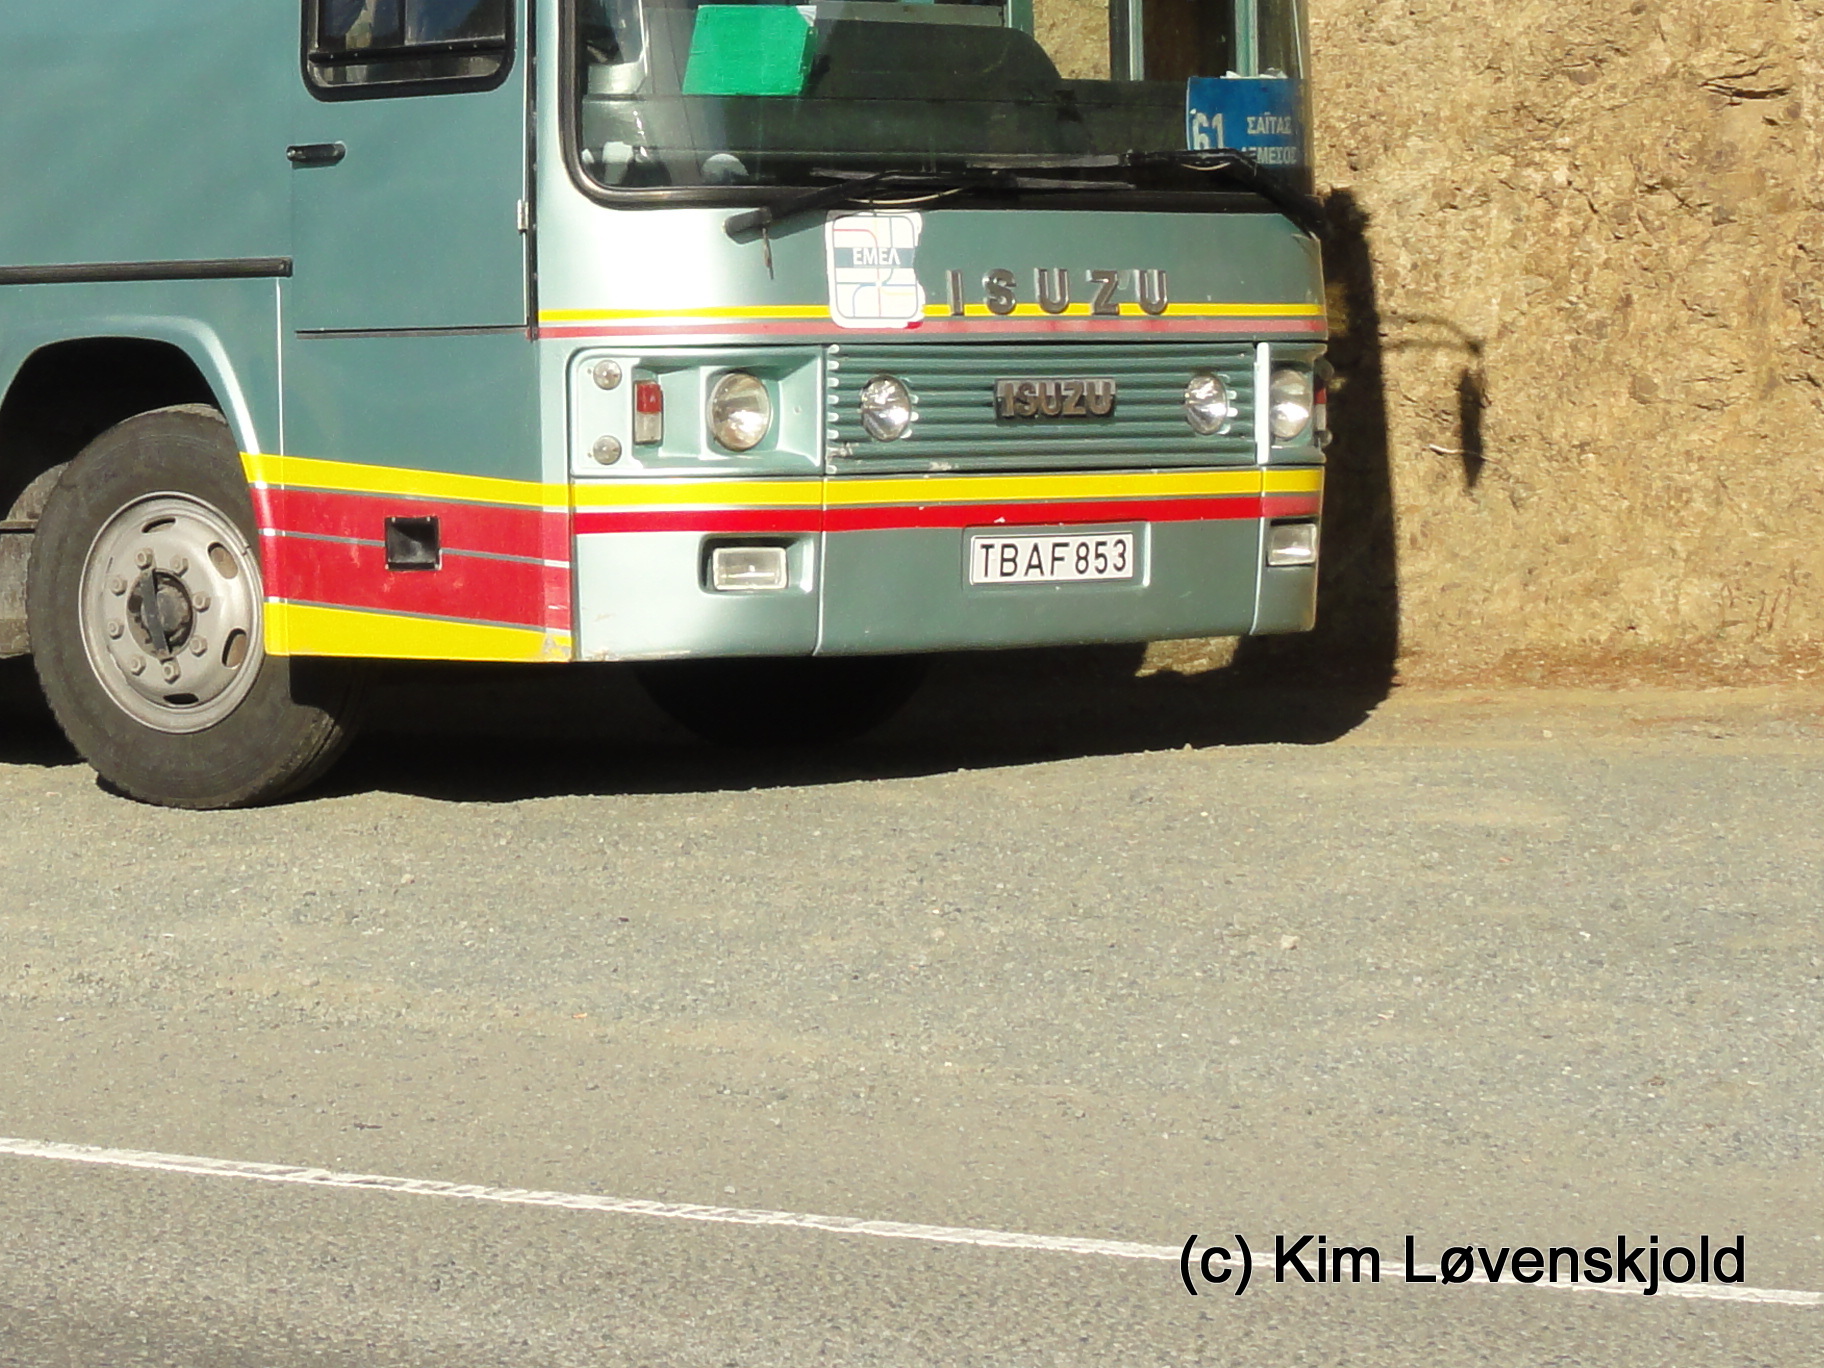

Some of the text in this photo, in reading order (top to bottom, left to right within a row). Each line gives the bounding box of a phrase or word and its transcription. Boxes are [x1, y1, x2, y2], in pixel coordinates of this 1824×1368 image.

[1192, 112, 1224, 150] 61
[1241, 146, 1298, 165] ΕΜΕΣΟΣ
[946, 267, 1169, 316] ISUZU
[996, 380, 1113, 418] ISUZU
[980, 539, 1127, 579] TBAF853
